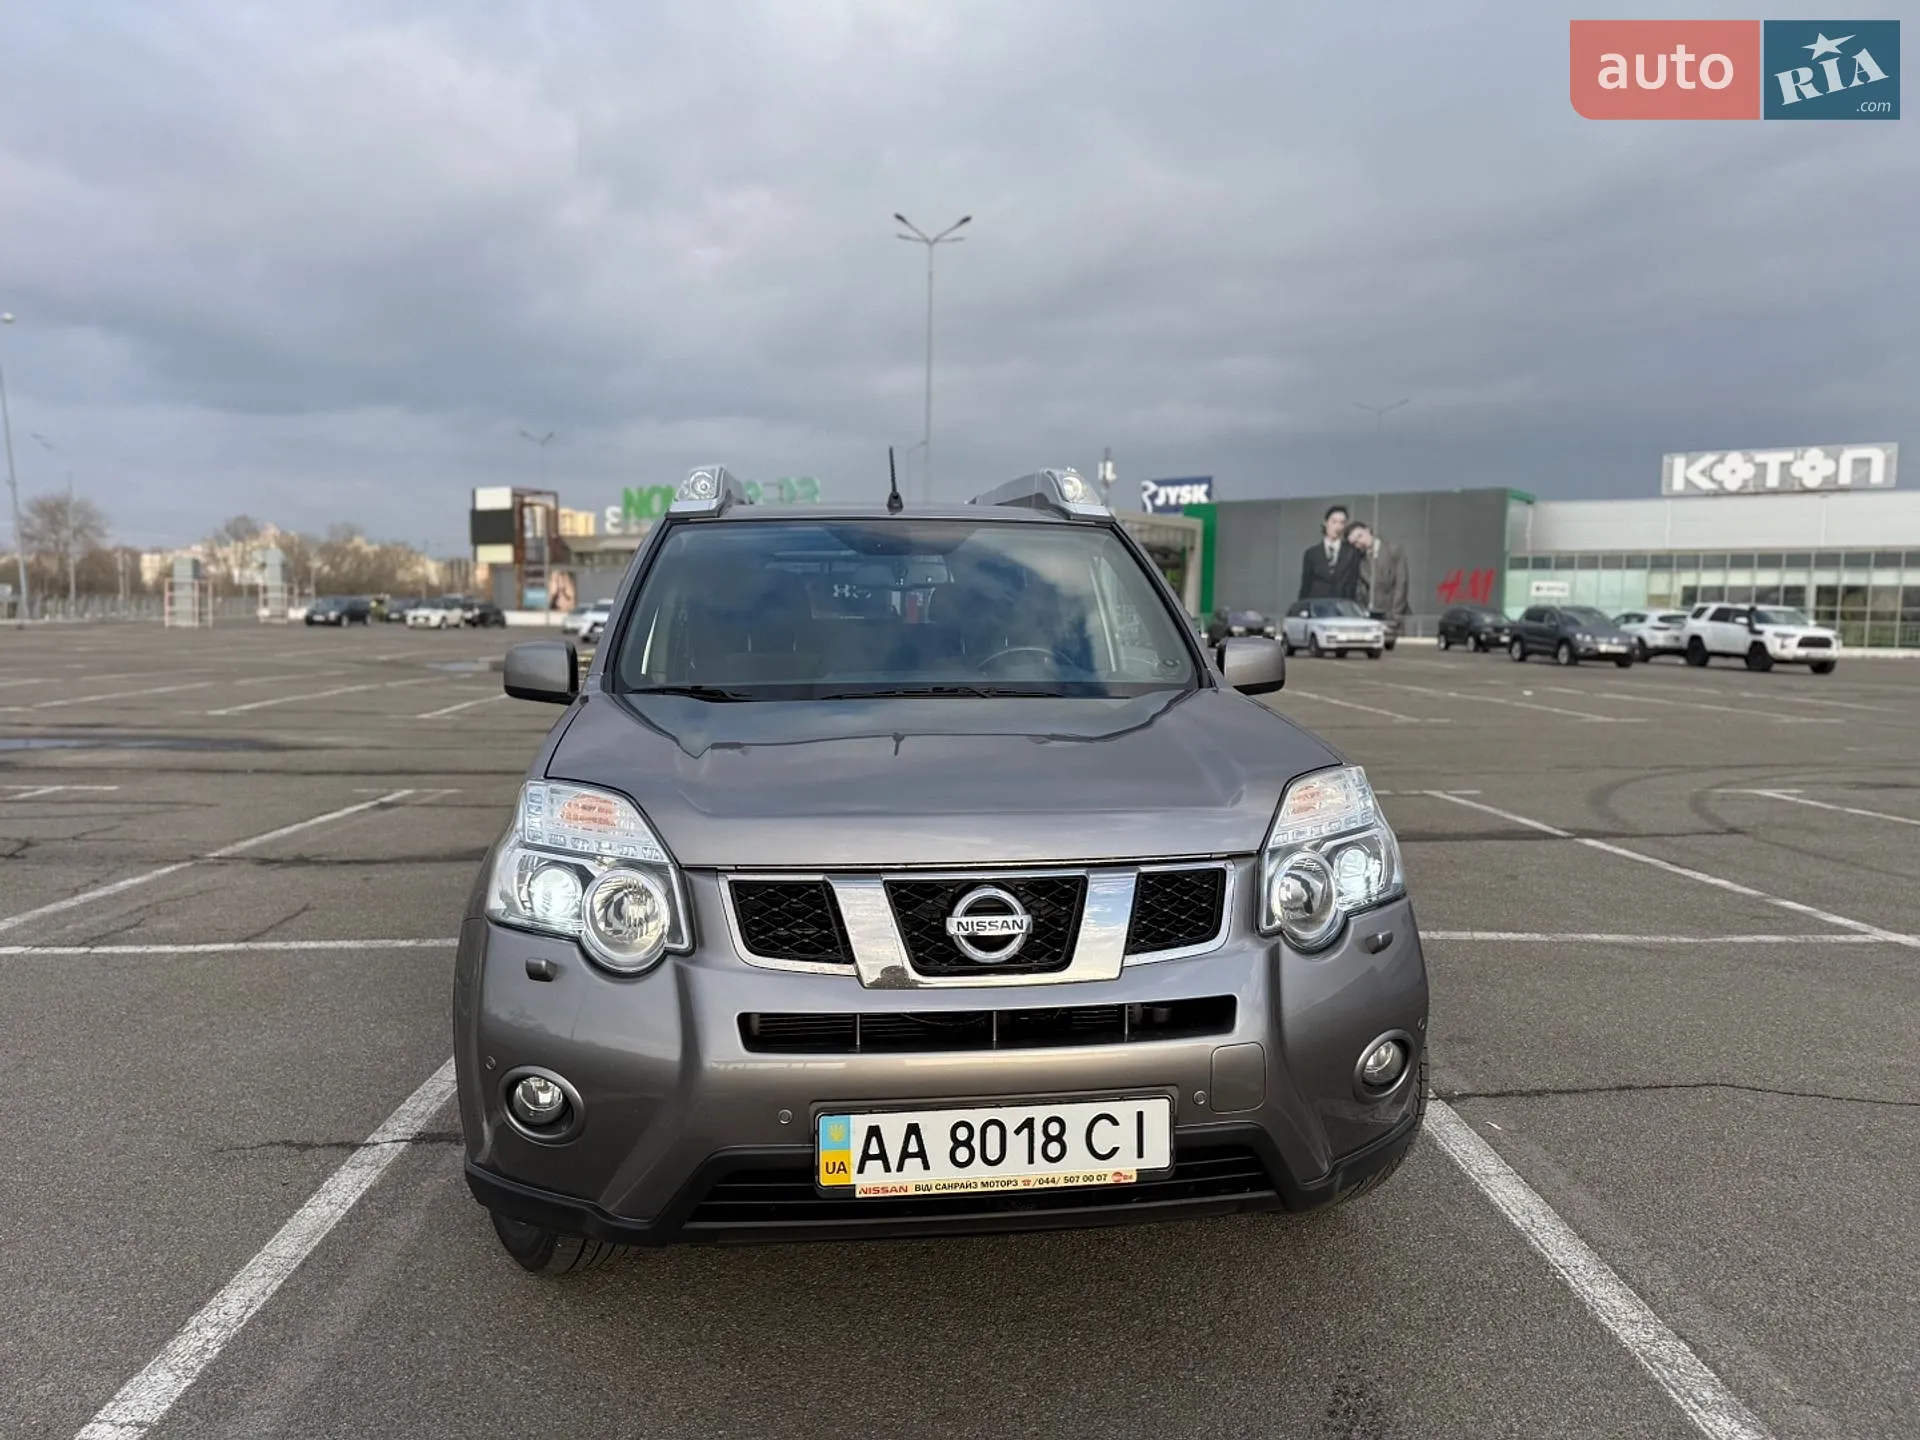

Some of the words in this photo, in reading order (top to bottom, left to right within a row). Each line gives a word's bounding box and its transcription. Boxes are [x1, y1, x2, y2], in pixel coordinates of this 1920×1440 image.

[1154, 484, 1209, 506] JYSK
[956, 918, 1024, 932] NISSAN
[856, 1122, 931, 1175] AA
[949, 1115, 1068, 1169] 8018
[824, 1160, 848, 1175] UA
[858, 1184, 909, 1196] NISSAN
[1063, 1175, 1080, 1184] 507
[1082, 1174, 1095, 1183] 00
[1096, 1173, 1108, 1182] 07
